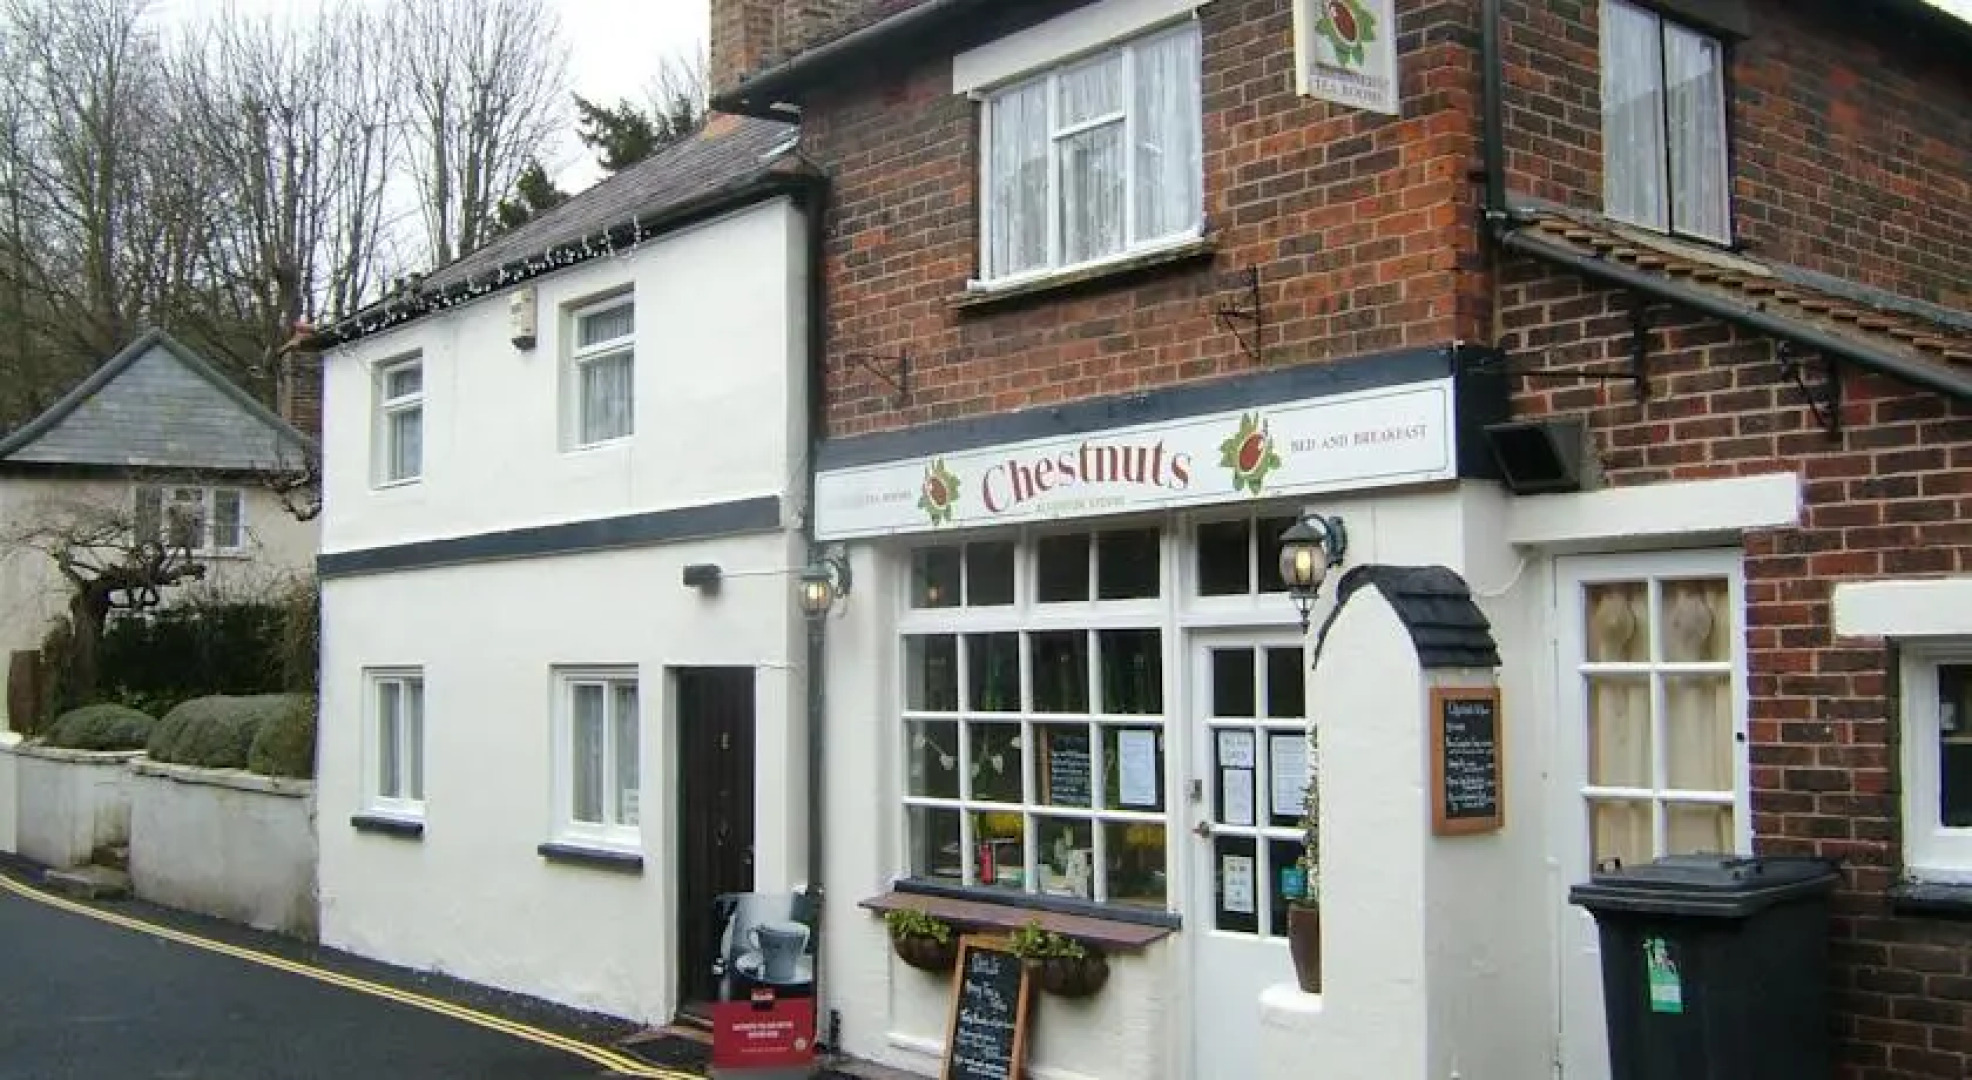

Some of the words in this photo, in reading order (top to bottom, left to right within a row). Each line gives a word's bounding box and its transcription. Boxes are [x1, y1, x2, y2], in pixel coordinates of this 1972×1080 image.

[1290, 438, 1316, 453] BED
[1321, 433, 1348, 449] AND
[1353, 424, 1428, 446] BREAKFAST
[982, 438, 1192, 514] Chestnuts
